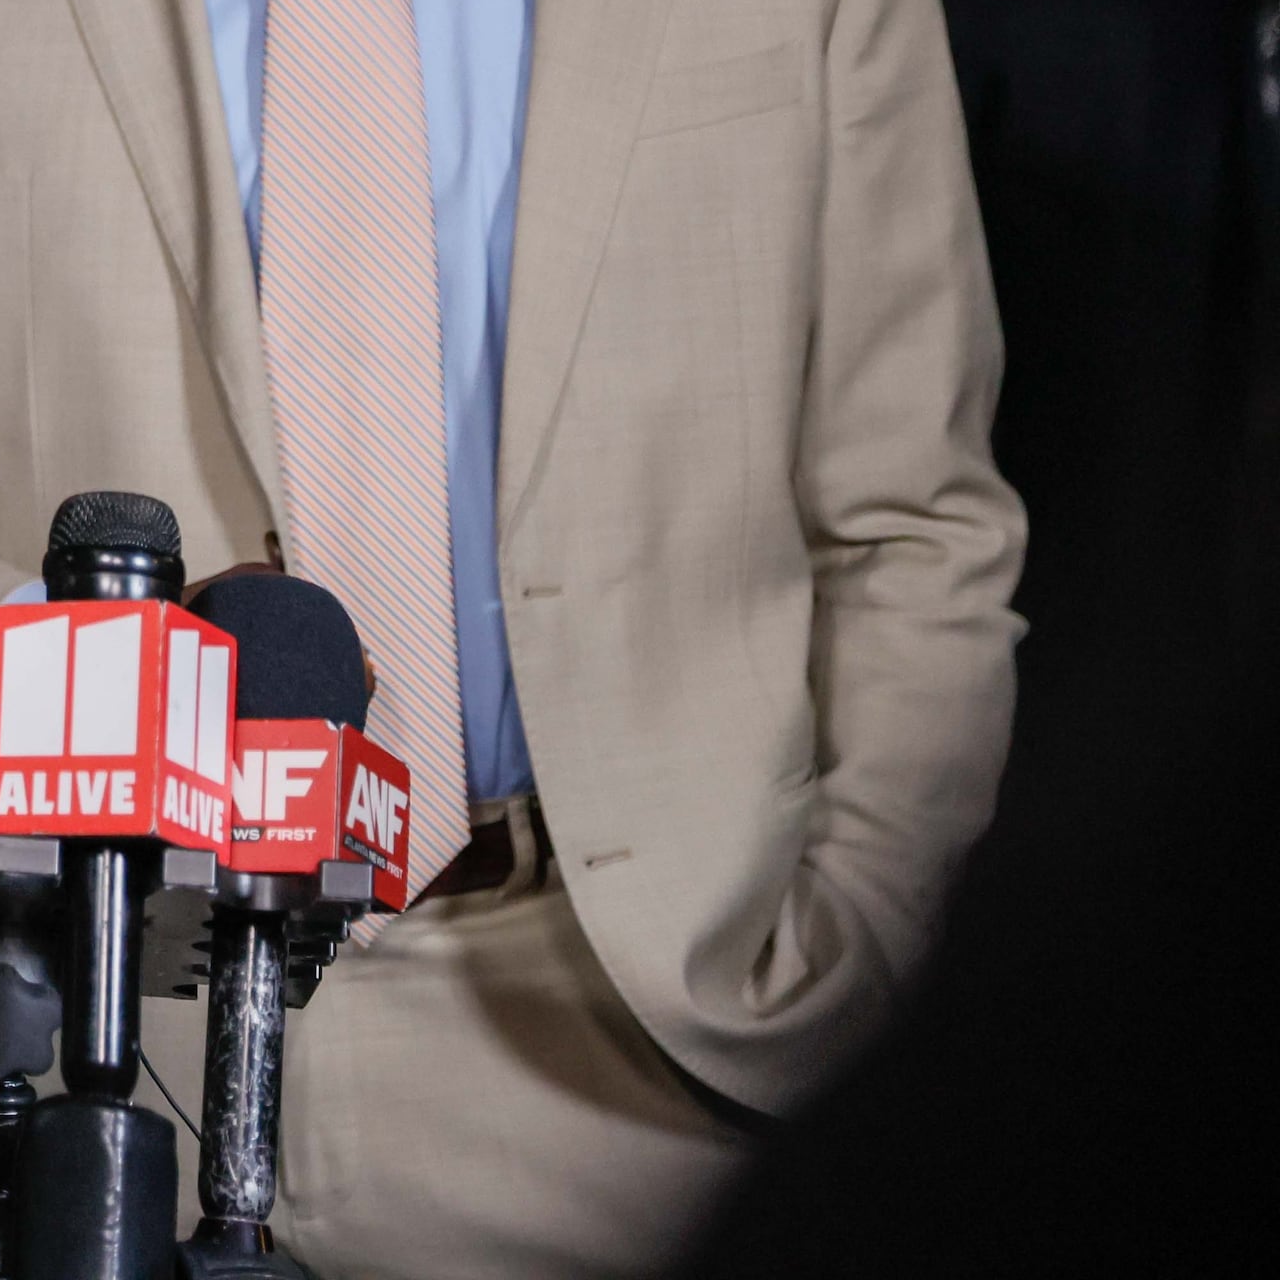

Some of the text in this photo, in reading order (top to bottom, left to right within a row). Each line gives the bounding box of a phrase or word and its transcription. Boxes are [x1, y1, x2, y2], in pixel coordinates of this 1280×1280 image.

[0, 613, 141, 757] 11
[163, 776, 224, 844] ALIVE
[232, 749, 328, 821] NF
[346, 764, 408, 855] ANF
[266, 828, 317, 841] FIRST
[369, 850, 386, 870] NEWS
[387, 861, 403, 880] FIRST
